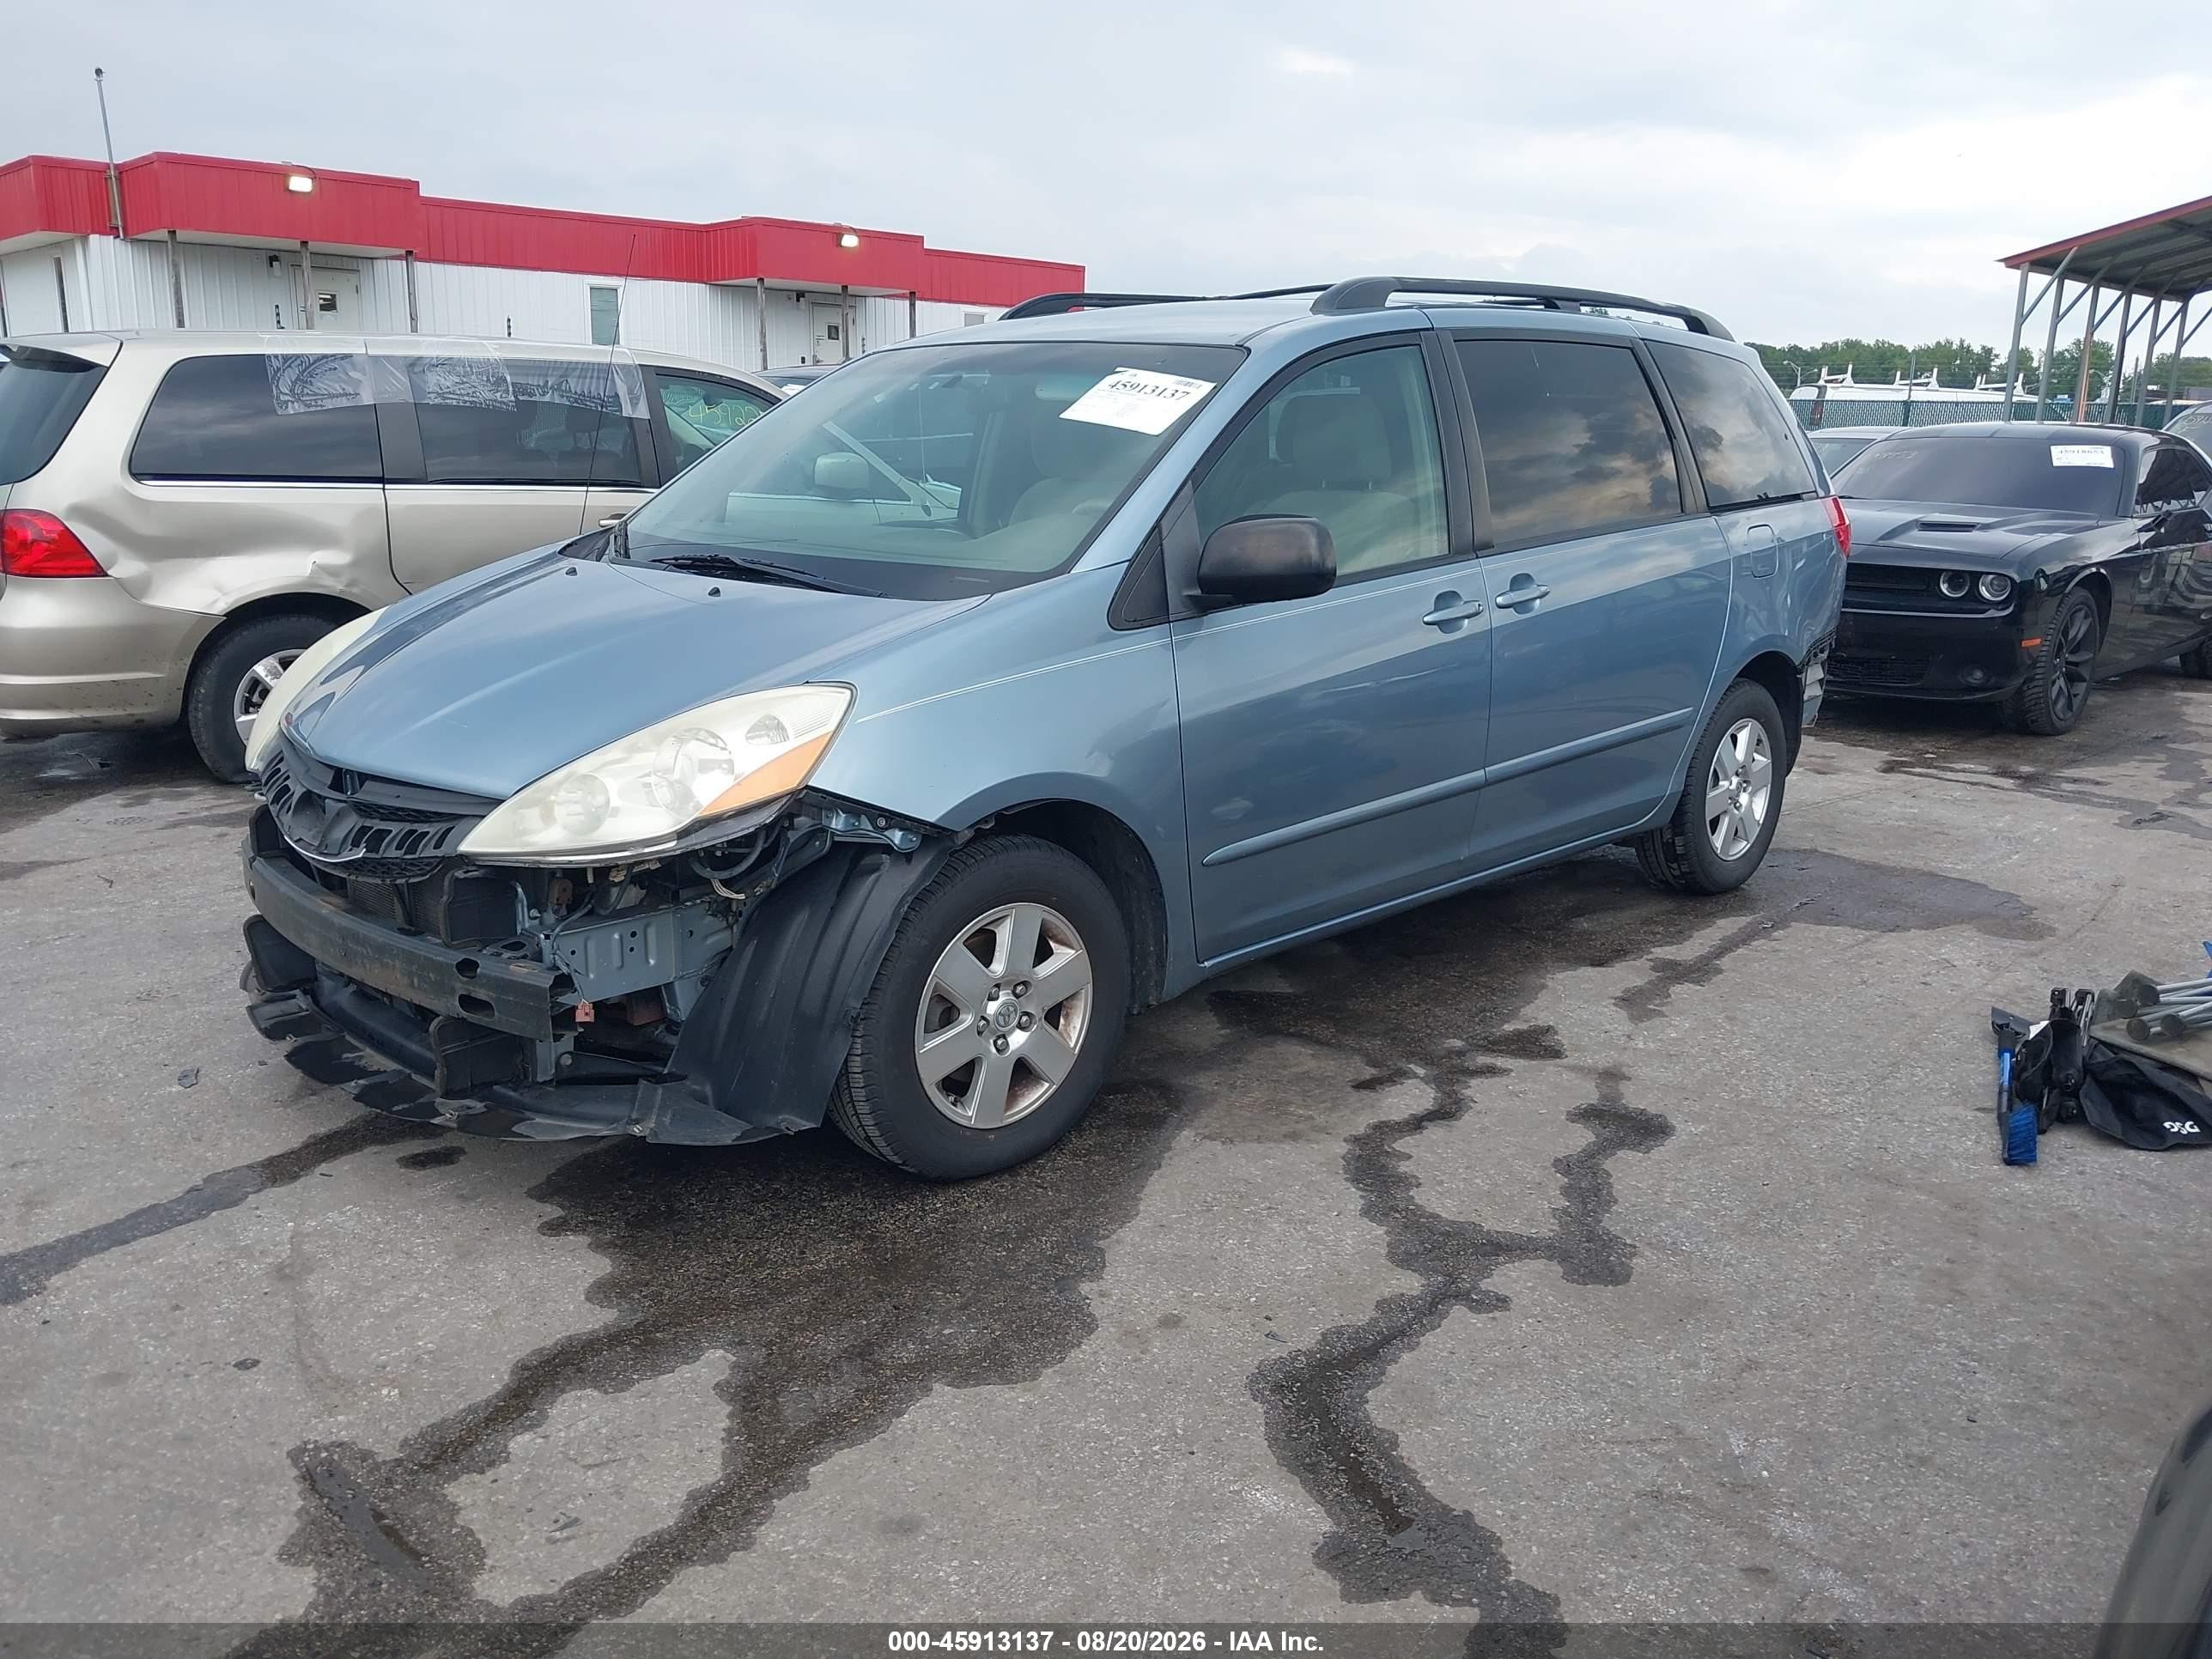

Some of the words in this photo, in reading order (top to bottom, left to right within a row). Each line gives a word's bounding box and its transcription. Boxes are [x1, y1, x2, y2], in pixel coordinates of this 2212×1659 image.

[1108, 380, 1192, 401] 45913137
[688, 403, 764, 426] 45922
[2162, 1121, 2201, 1134] DSG
